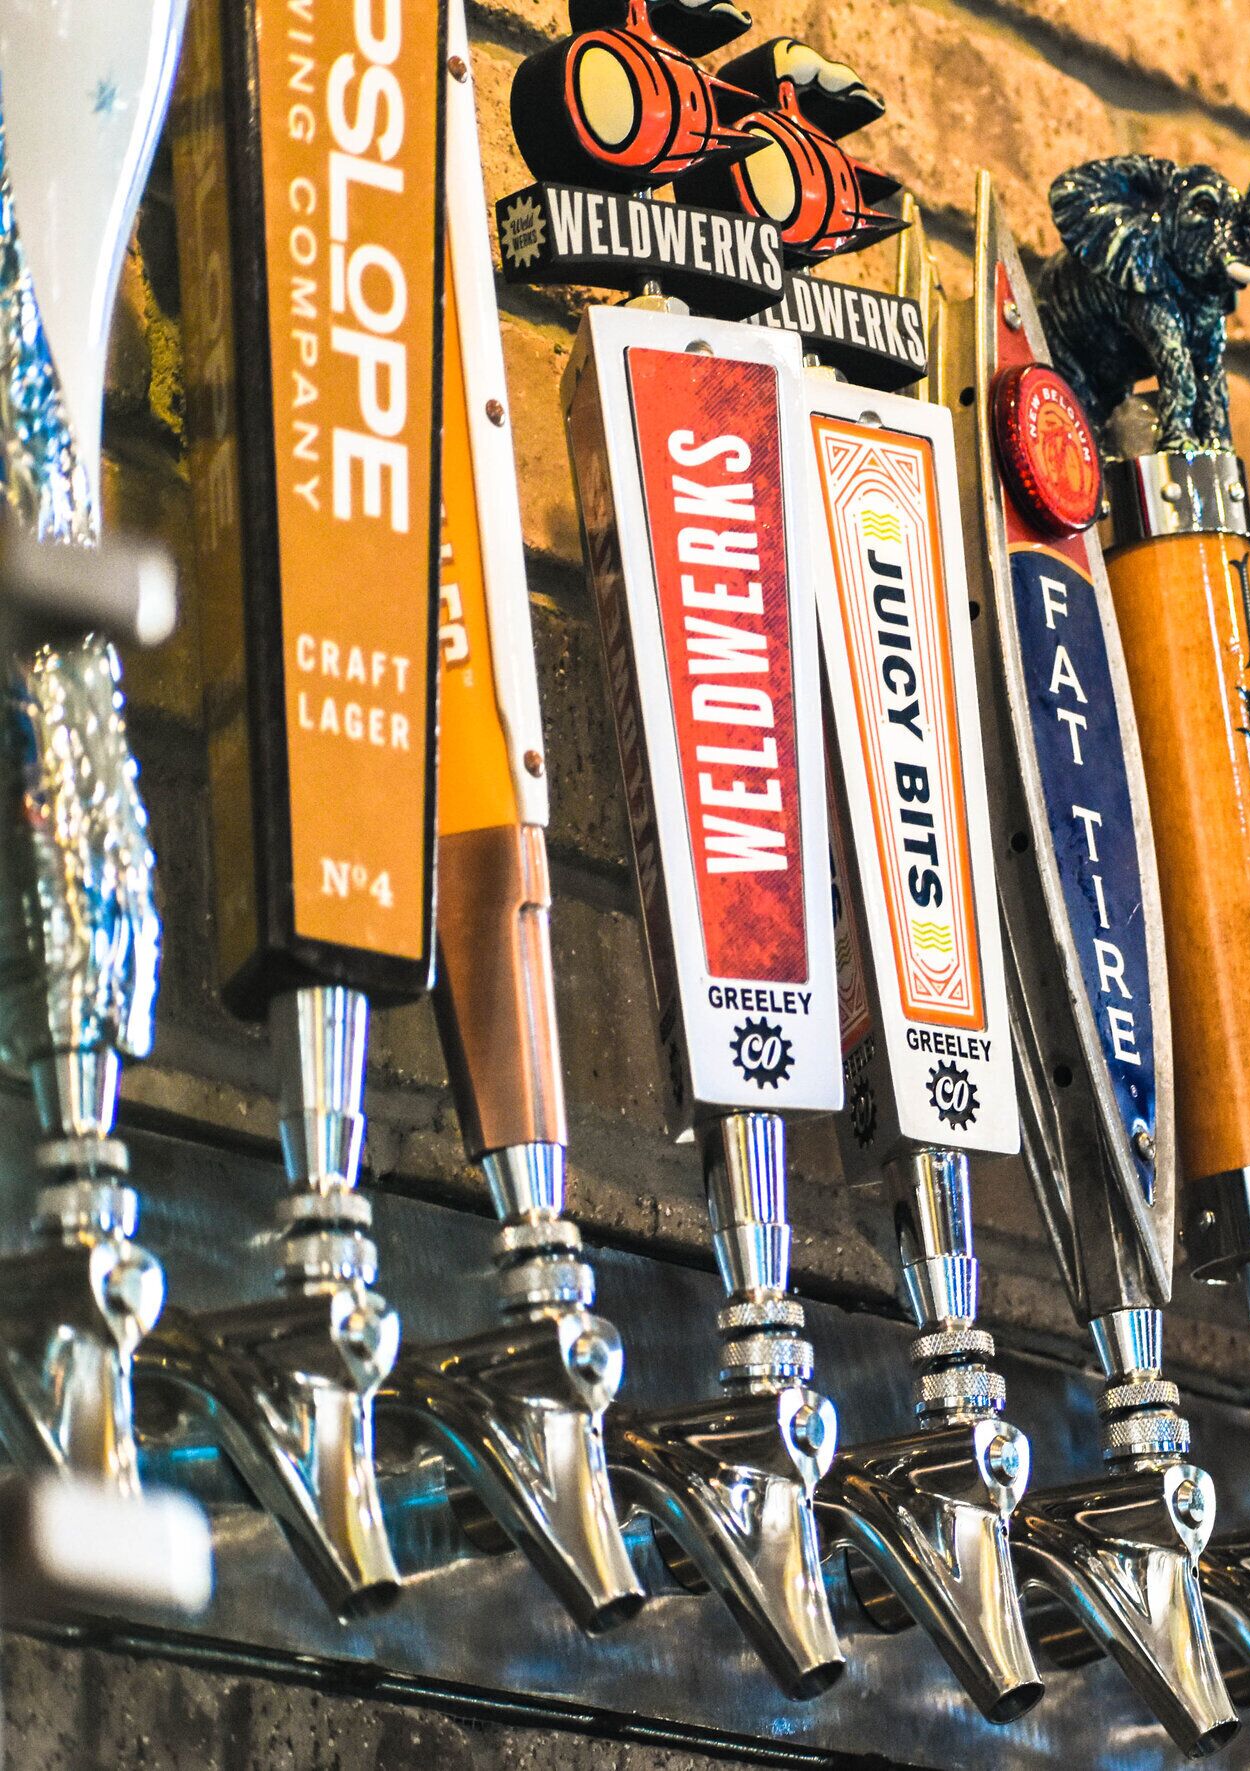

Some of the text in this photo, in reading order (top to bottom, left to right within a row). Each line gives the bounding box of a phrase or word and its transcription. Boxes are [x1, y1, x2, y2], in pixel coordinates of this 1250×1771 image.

[512, 229, 538, 252] WERKS
[547, 187, 783, 291] WELDWERKS
[289, 177, 320, 511] COMPANY
[740, 277, 926, 367] LDWERKS
[1028, 386, 1092, 463] NEW BELGIUM
[296, 633, 411, 694] CRAFT
[667, 428, 790, 874] WELDWERKS
[298, 691, 410, 751] LAGER
[868, 548, 944, 909] JUICY BITS
[1040, 574, 1142, 1067] FAT TIRE
[708, 985, 812, 1015] GREELEY
[741, 1033, 782, 1071] CO
[906, 1027, 991, 1062] GREELEY
[935, 1076, 969, 1112] CO
